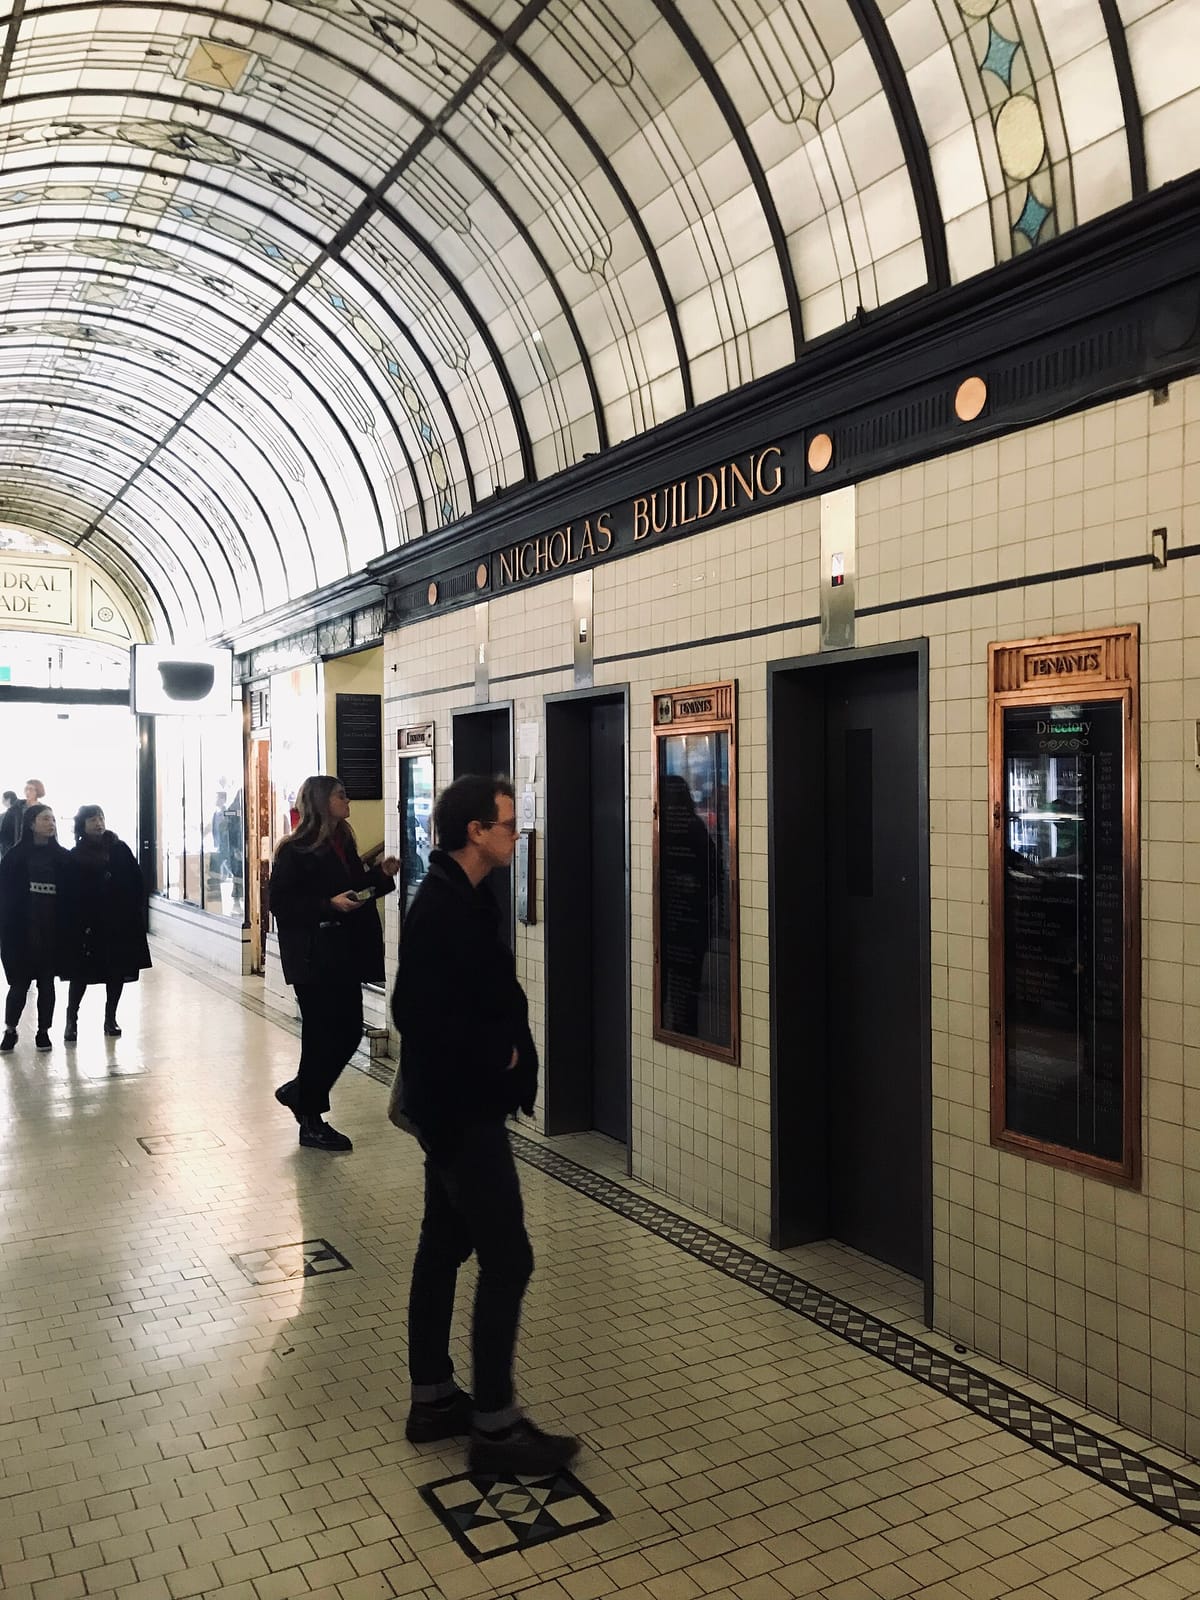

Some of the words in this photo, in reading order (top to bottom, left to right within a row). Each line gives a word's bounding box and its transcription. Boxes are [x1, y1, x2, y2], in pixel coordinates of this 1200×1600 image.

[500, 512, 612, 585] NICHOLAS
[633, 447, 782, 541] BUILDING
[0, 572, 62, 592] DRAL
[1030, 653, 1099, 676] TENANTS
[1036, 720, 1092, 735] Directory
